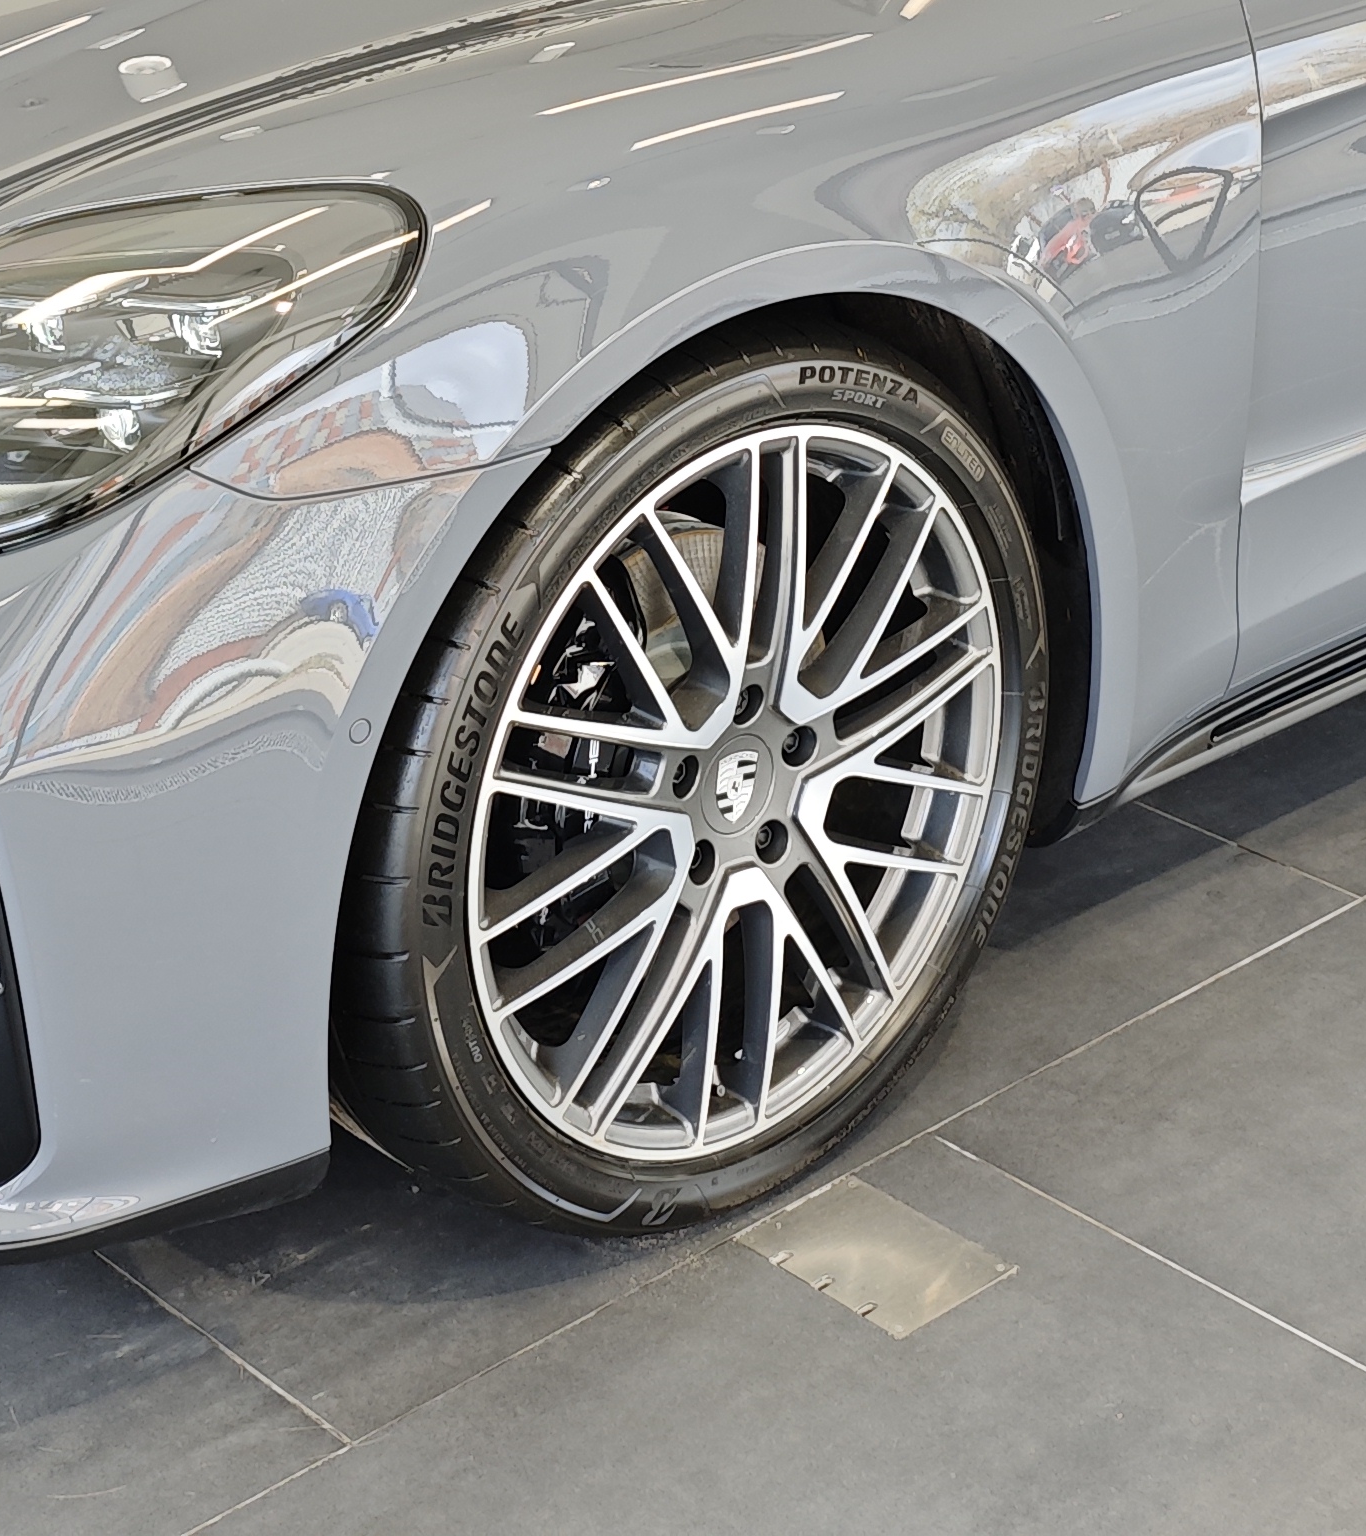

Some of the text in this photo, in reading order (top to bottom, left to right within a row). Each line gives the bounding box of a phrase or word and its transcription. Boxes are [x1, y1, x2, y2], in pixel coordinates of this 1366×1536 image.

[798, 365, 921, 409] POTENZA
[831, 388, 887, 409] SPORT
[421, 611, 525, 928] BRIDGESTONE
[971, 680, 1046, 949] BRIDGESTONE
